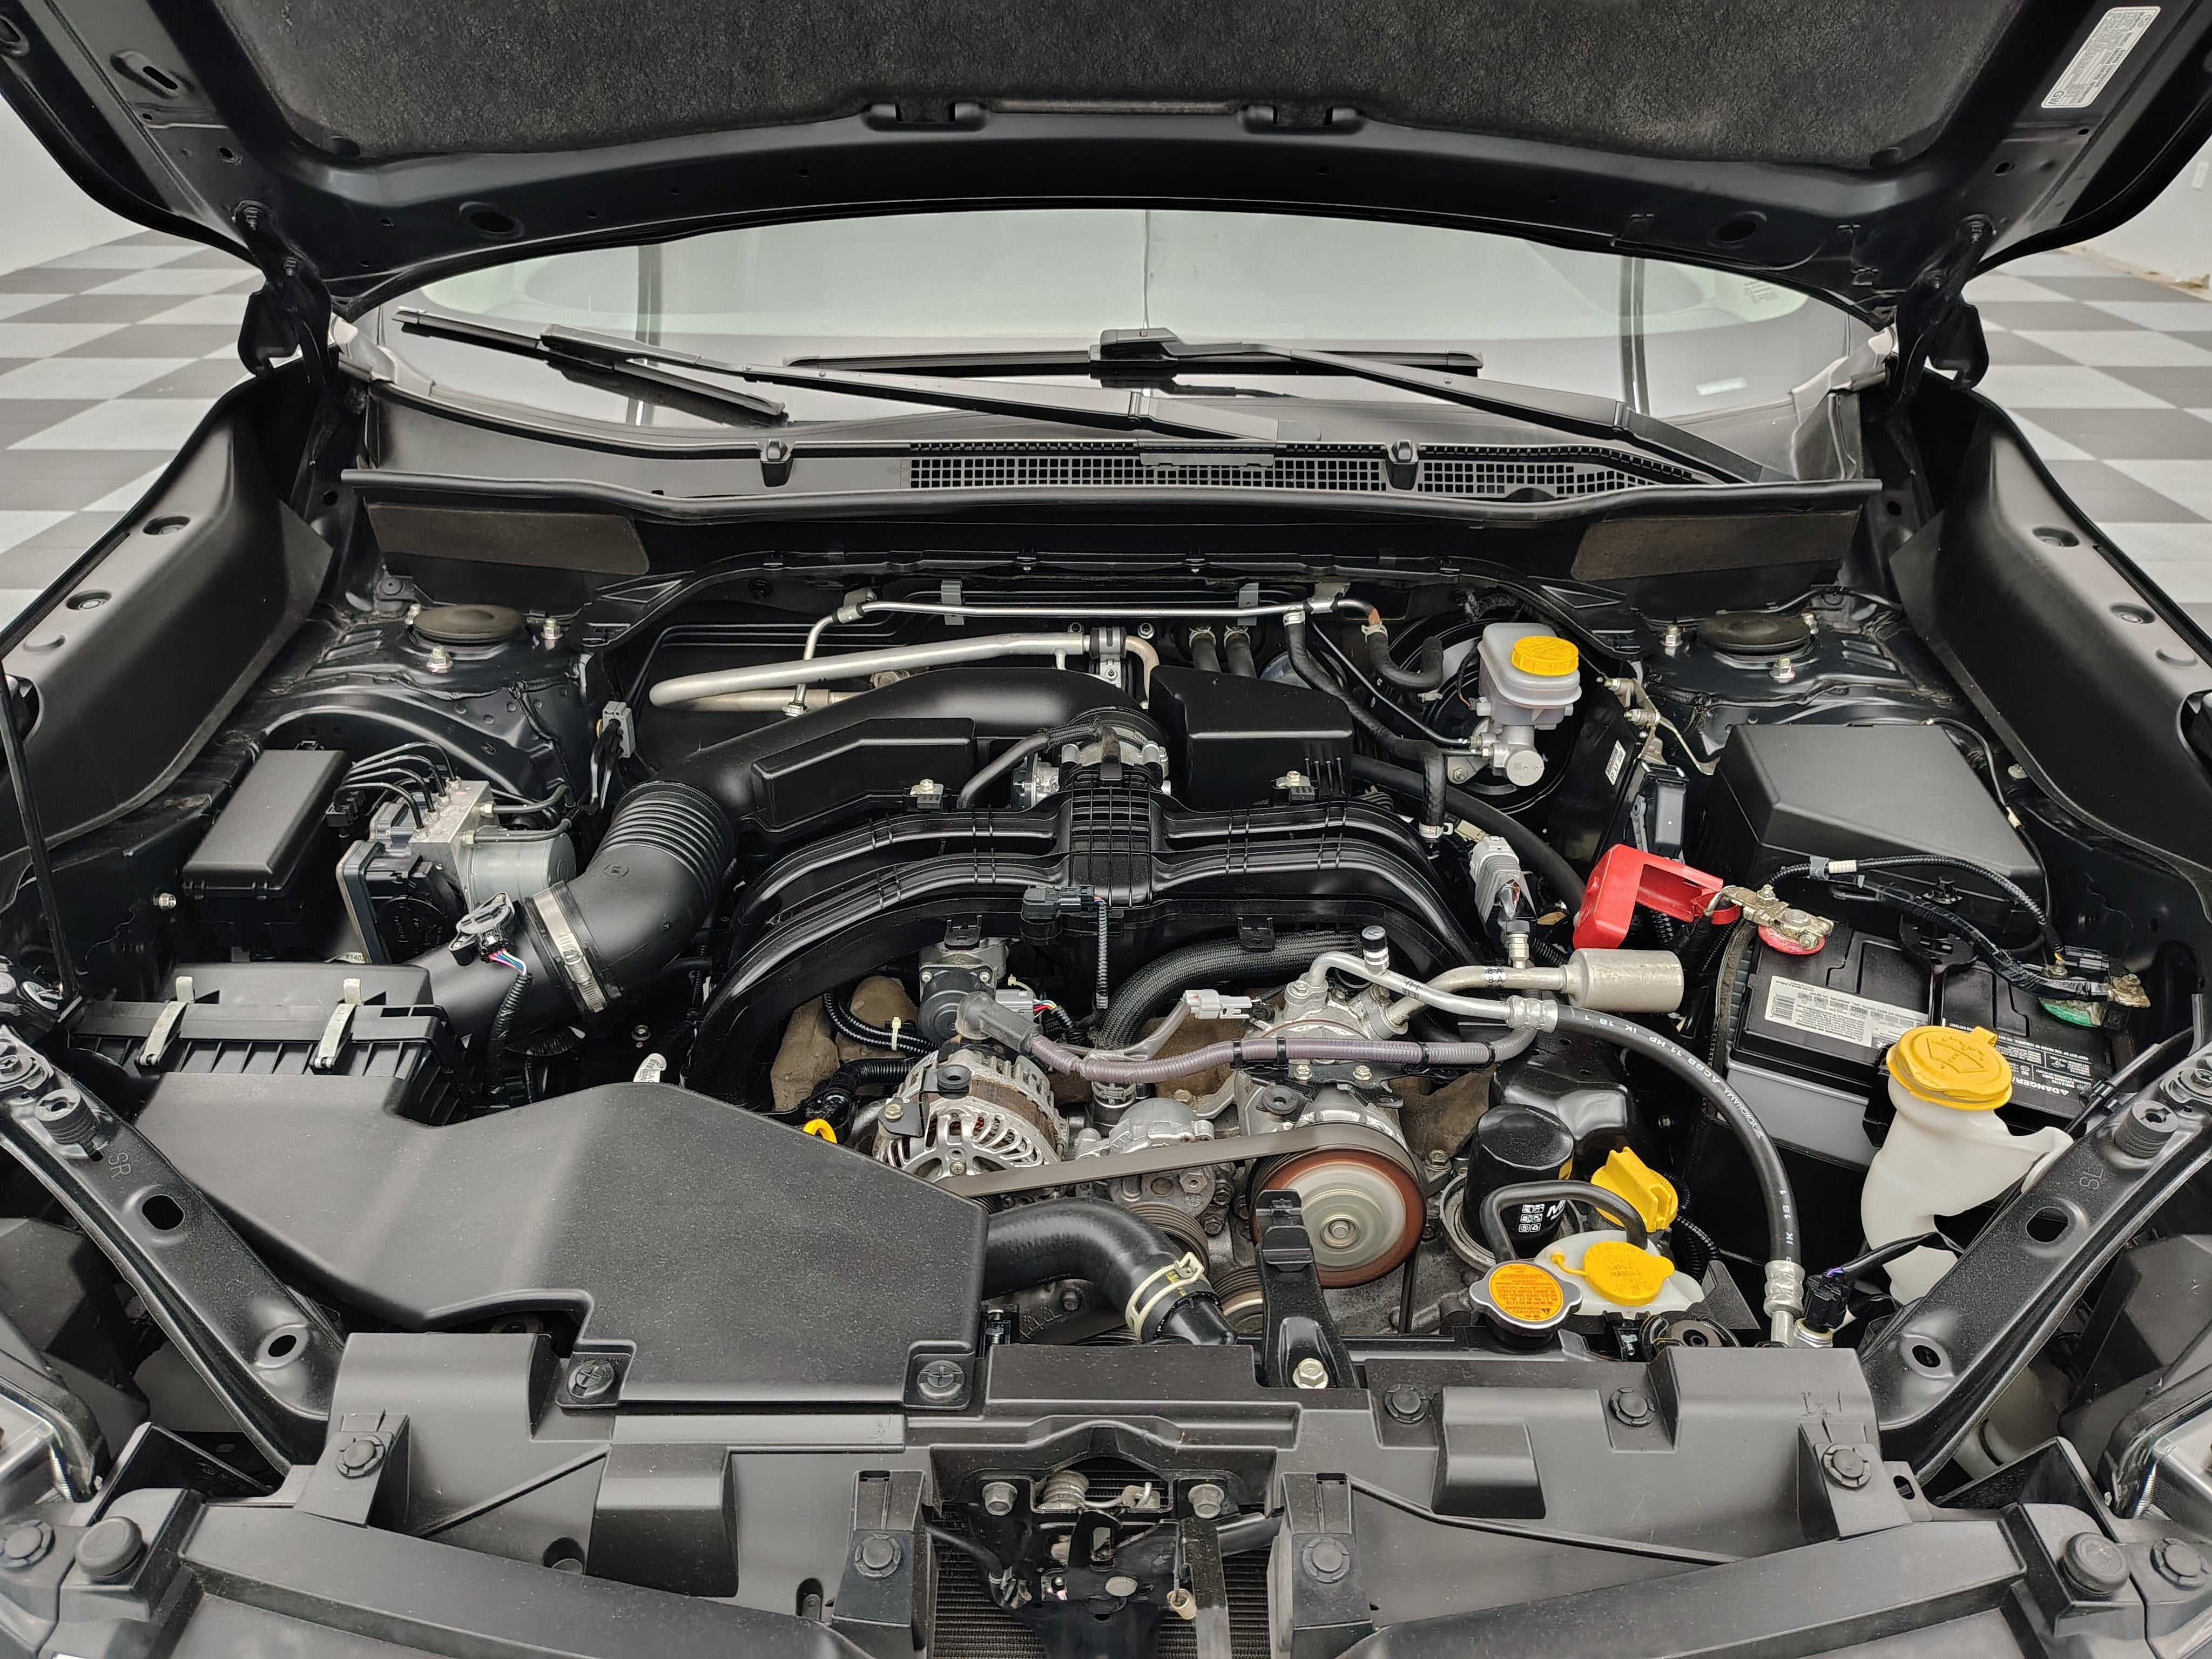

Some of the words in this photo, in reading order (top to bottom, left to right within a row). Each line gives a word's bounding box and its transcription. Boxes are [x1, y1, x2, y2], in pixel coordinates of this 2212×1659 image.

[2046, 91, 2066, 105] GW
[1649, 1036, 1666, 1047] HP
[1724, 1087, 1757, 1128] YOKOHAMA
[108, 1152, 131, 1178] SR
[2079, 1168, 2105, 1190] SL
